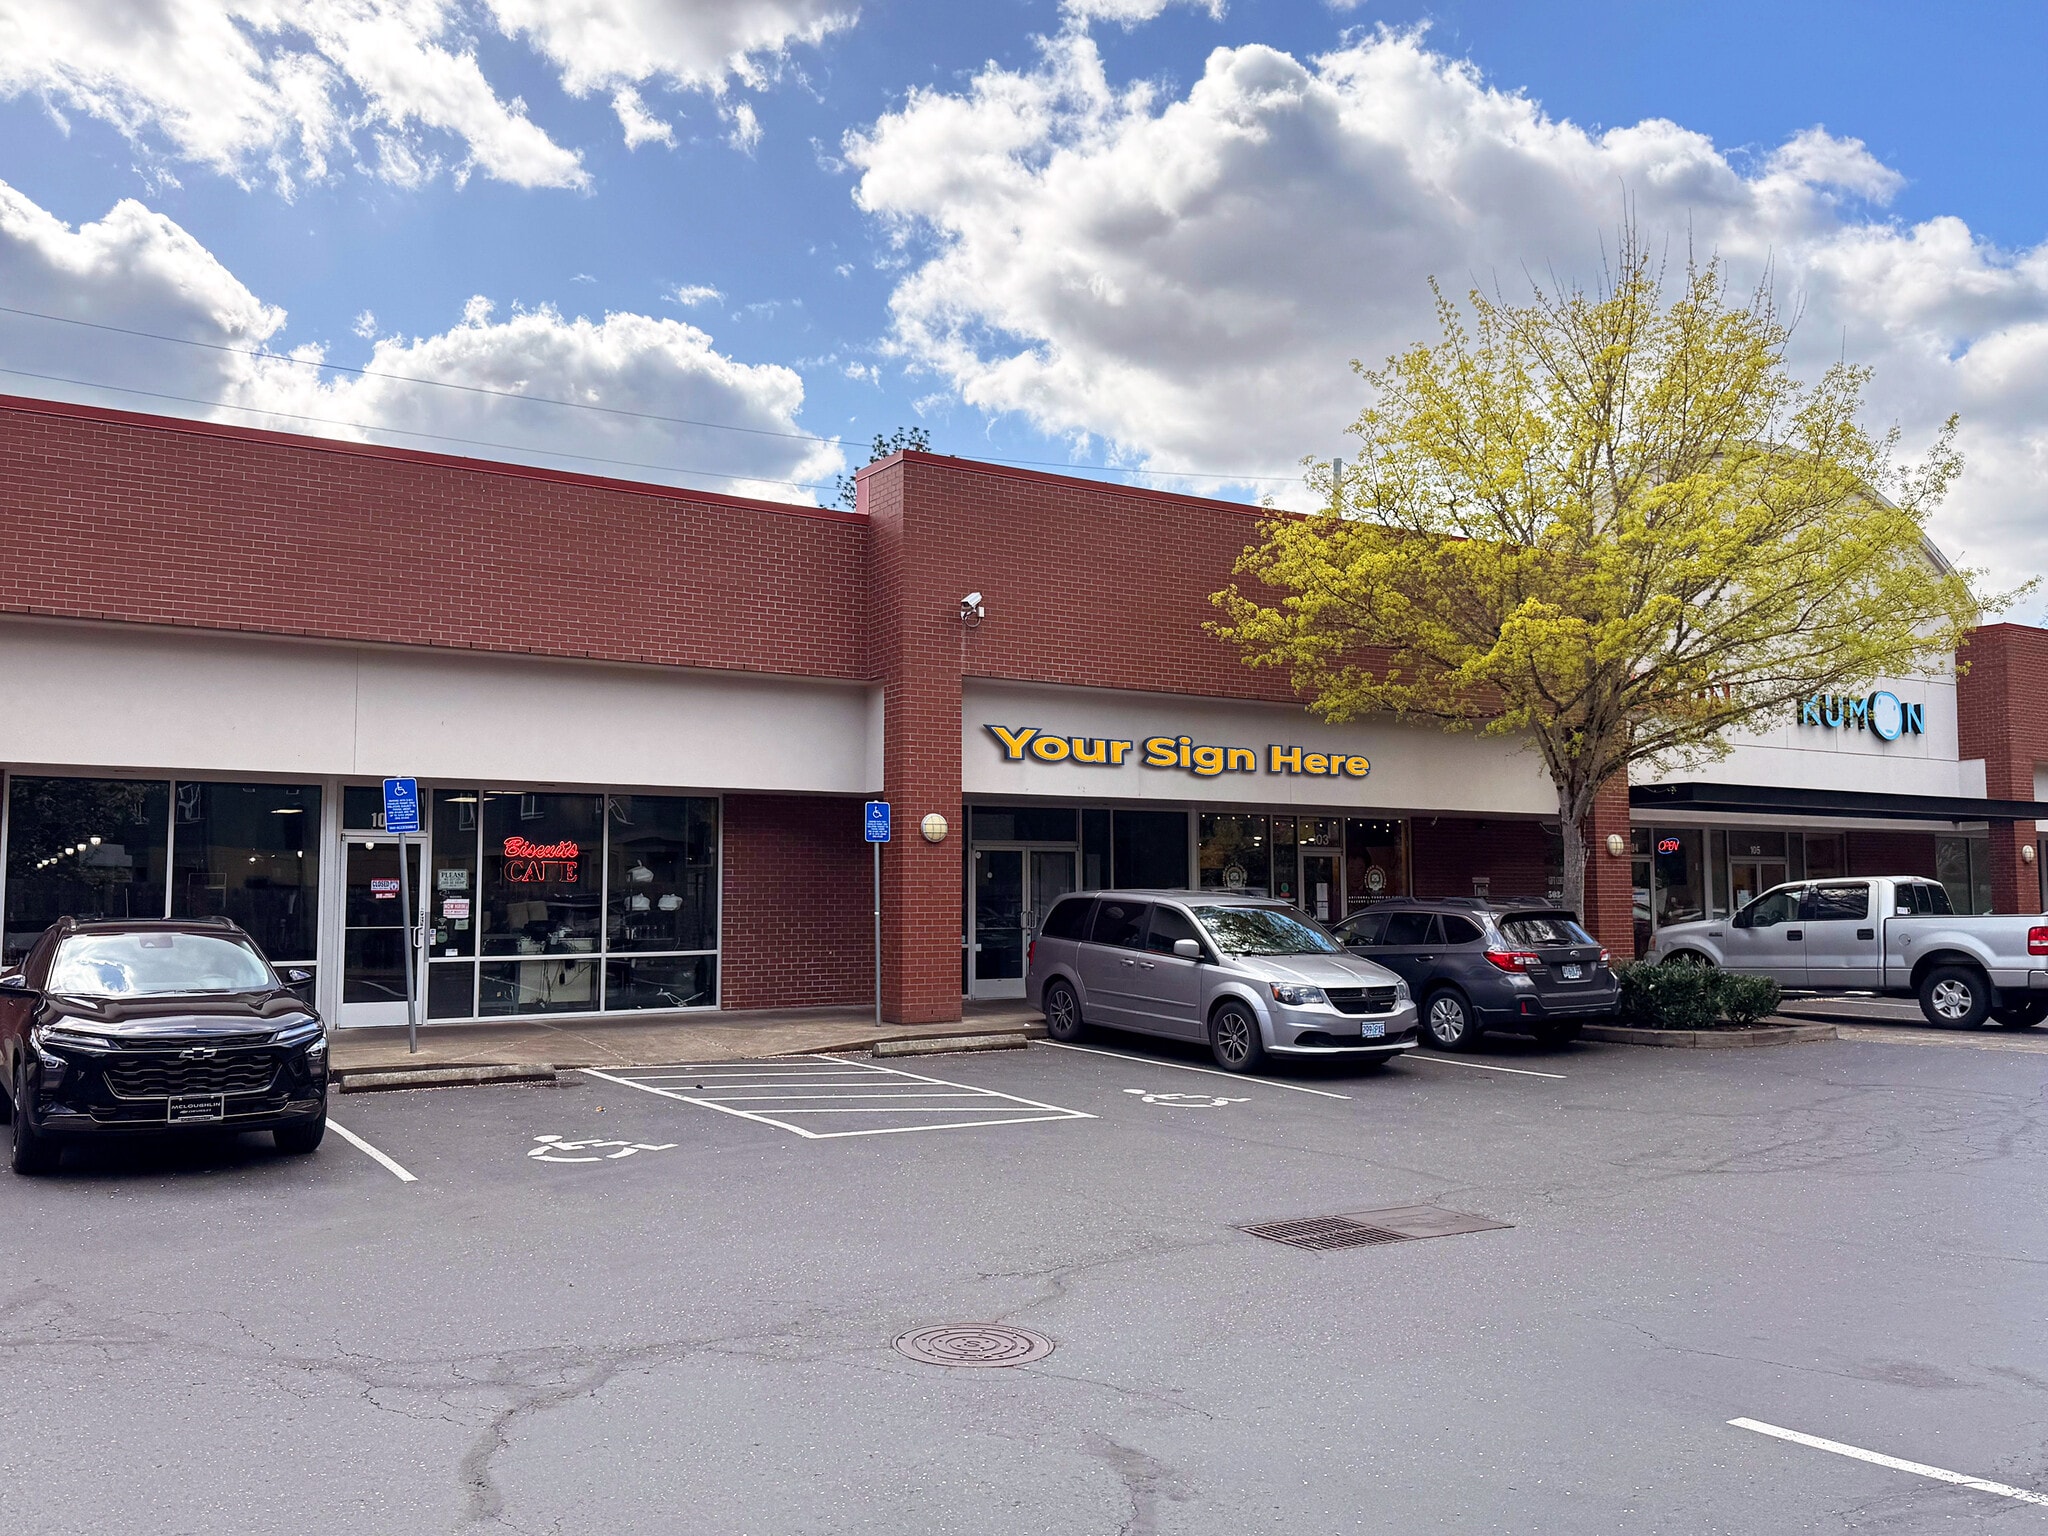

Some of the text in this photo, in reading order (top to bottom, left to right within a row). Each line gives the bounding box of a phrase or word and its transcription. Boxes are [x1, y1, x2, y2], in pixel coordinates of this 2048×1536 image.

[1797, 690, 1925, 741] KUMON
[983, 724, 1371, 778] Your Sign Here
[504, 836, 579, 859] Biscuits
[1658, 840, 1680, 851] OPEN
[1750, 845, 1761, 854] 105
[504, 860, 578, 882] CAFE
[171, 1102, 221, 1110] MCLOUGHLIN
